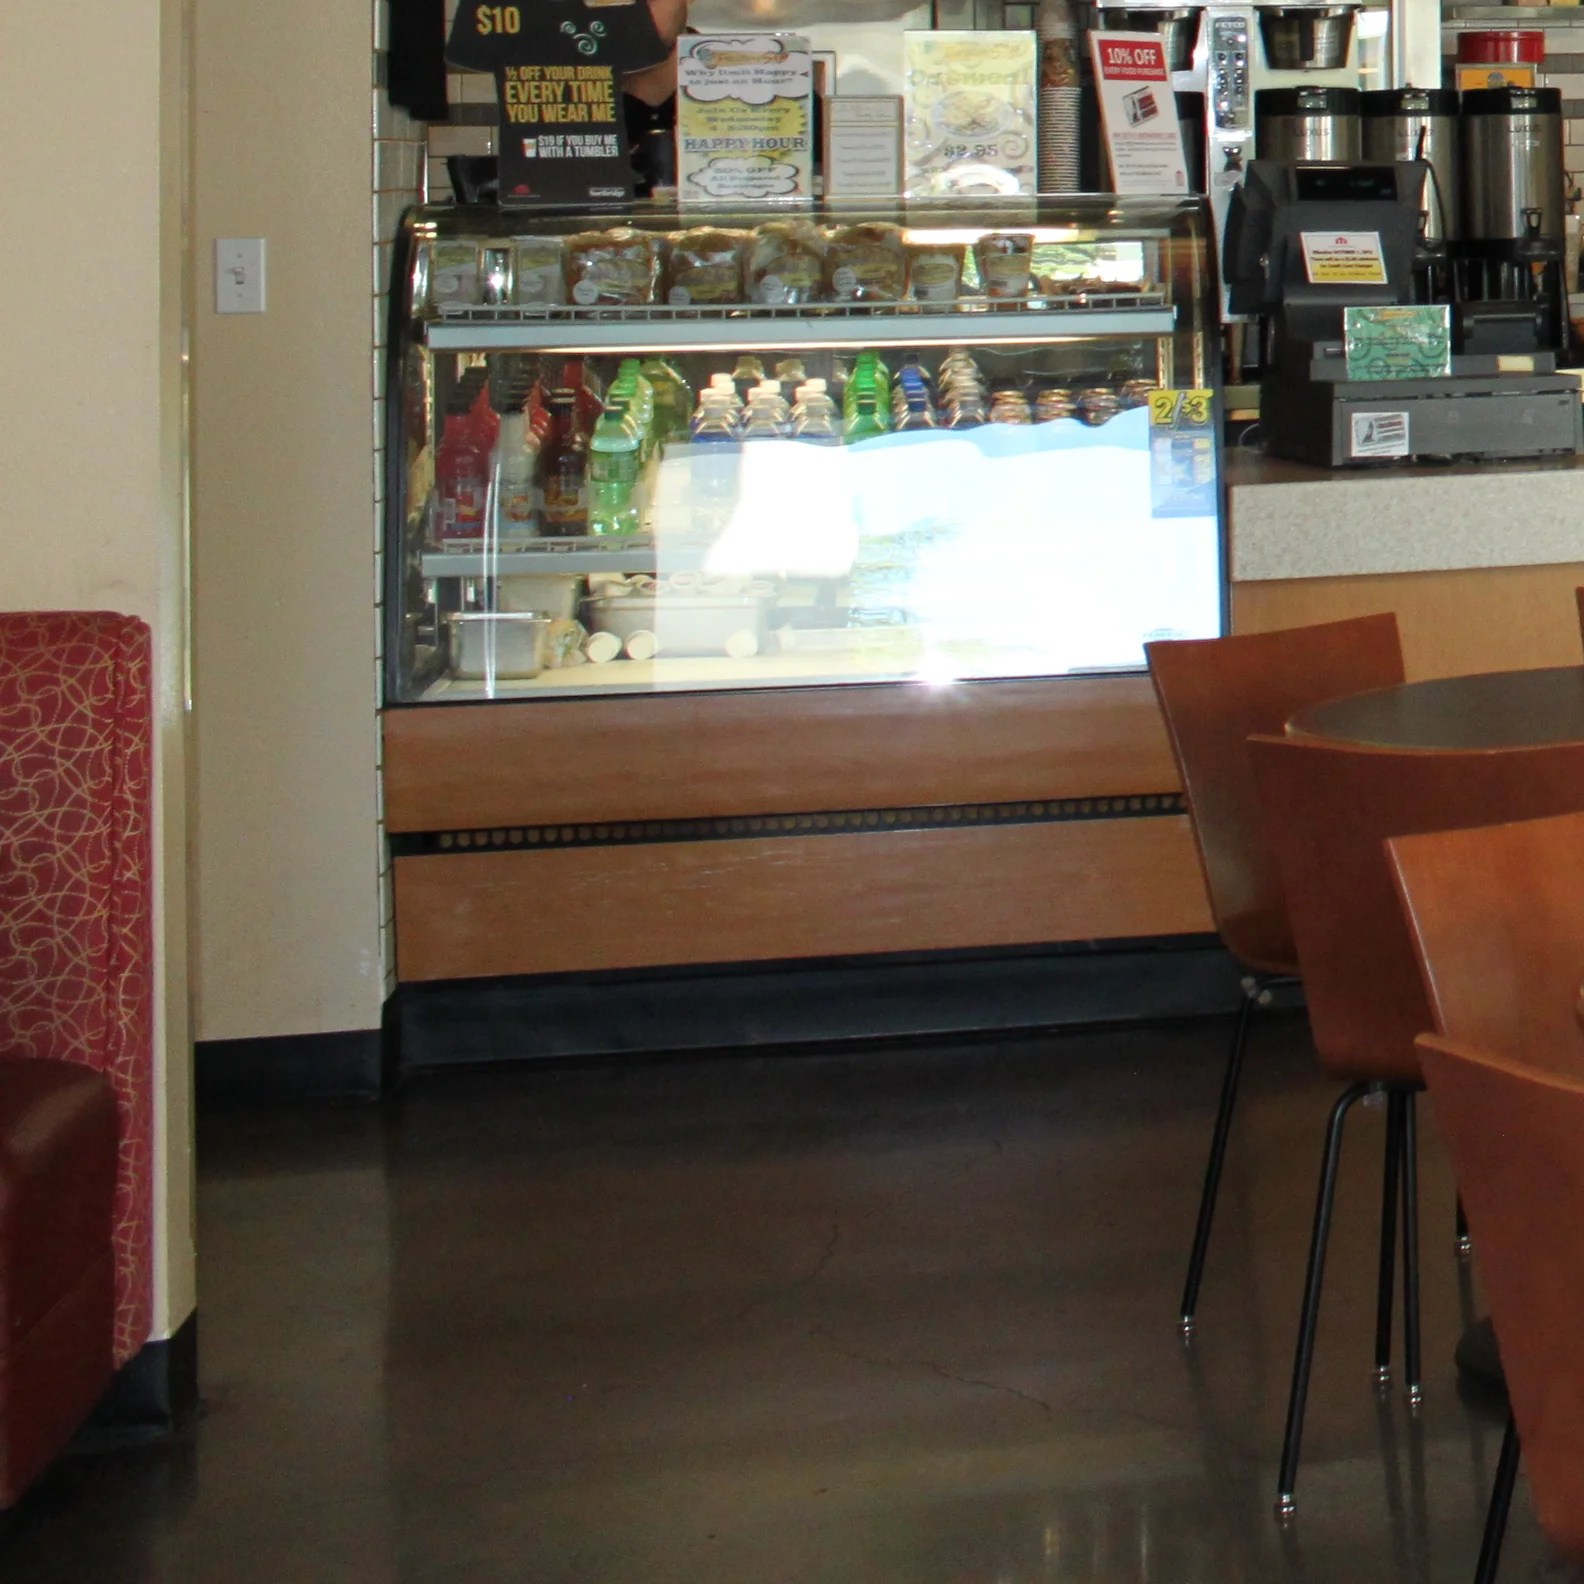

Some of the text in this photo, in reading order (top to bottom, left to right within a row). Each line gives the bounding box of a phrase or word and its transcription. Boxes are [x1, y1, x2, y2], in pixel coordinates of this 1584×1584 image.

[477, 6, 520, 35] $10
[1108, 48, 1157, 65] 10% OFF
[521, 67, 541, 79] OFF
[544, 67, 575, 79] YOUR
[579, 67, 613, 79] DRINK
[505, 82, 614, 103] EVERY TIME
[507, 104, 616, 123] YOU WEAR ME
[558, 135, 564, 146] IF
[567, 135, 584, 146] YOU
[586, 135, 602, 145] BUY
[605, 135, 617, 145] ME
[684, 138, 804, 149] HAPPY HOUR
[539, 146, 618, 158] WITH A TUMBLER
[1154, 392, 1209, 426] 2/$3
